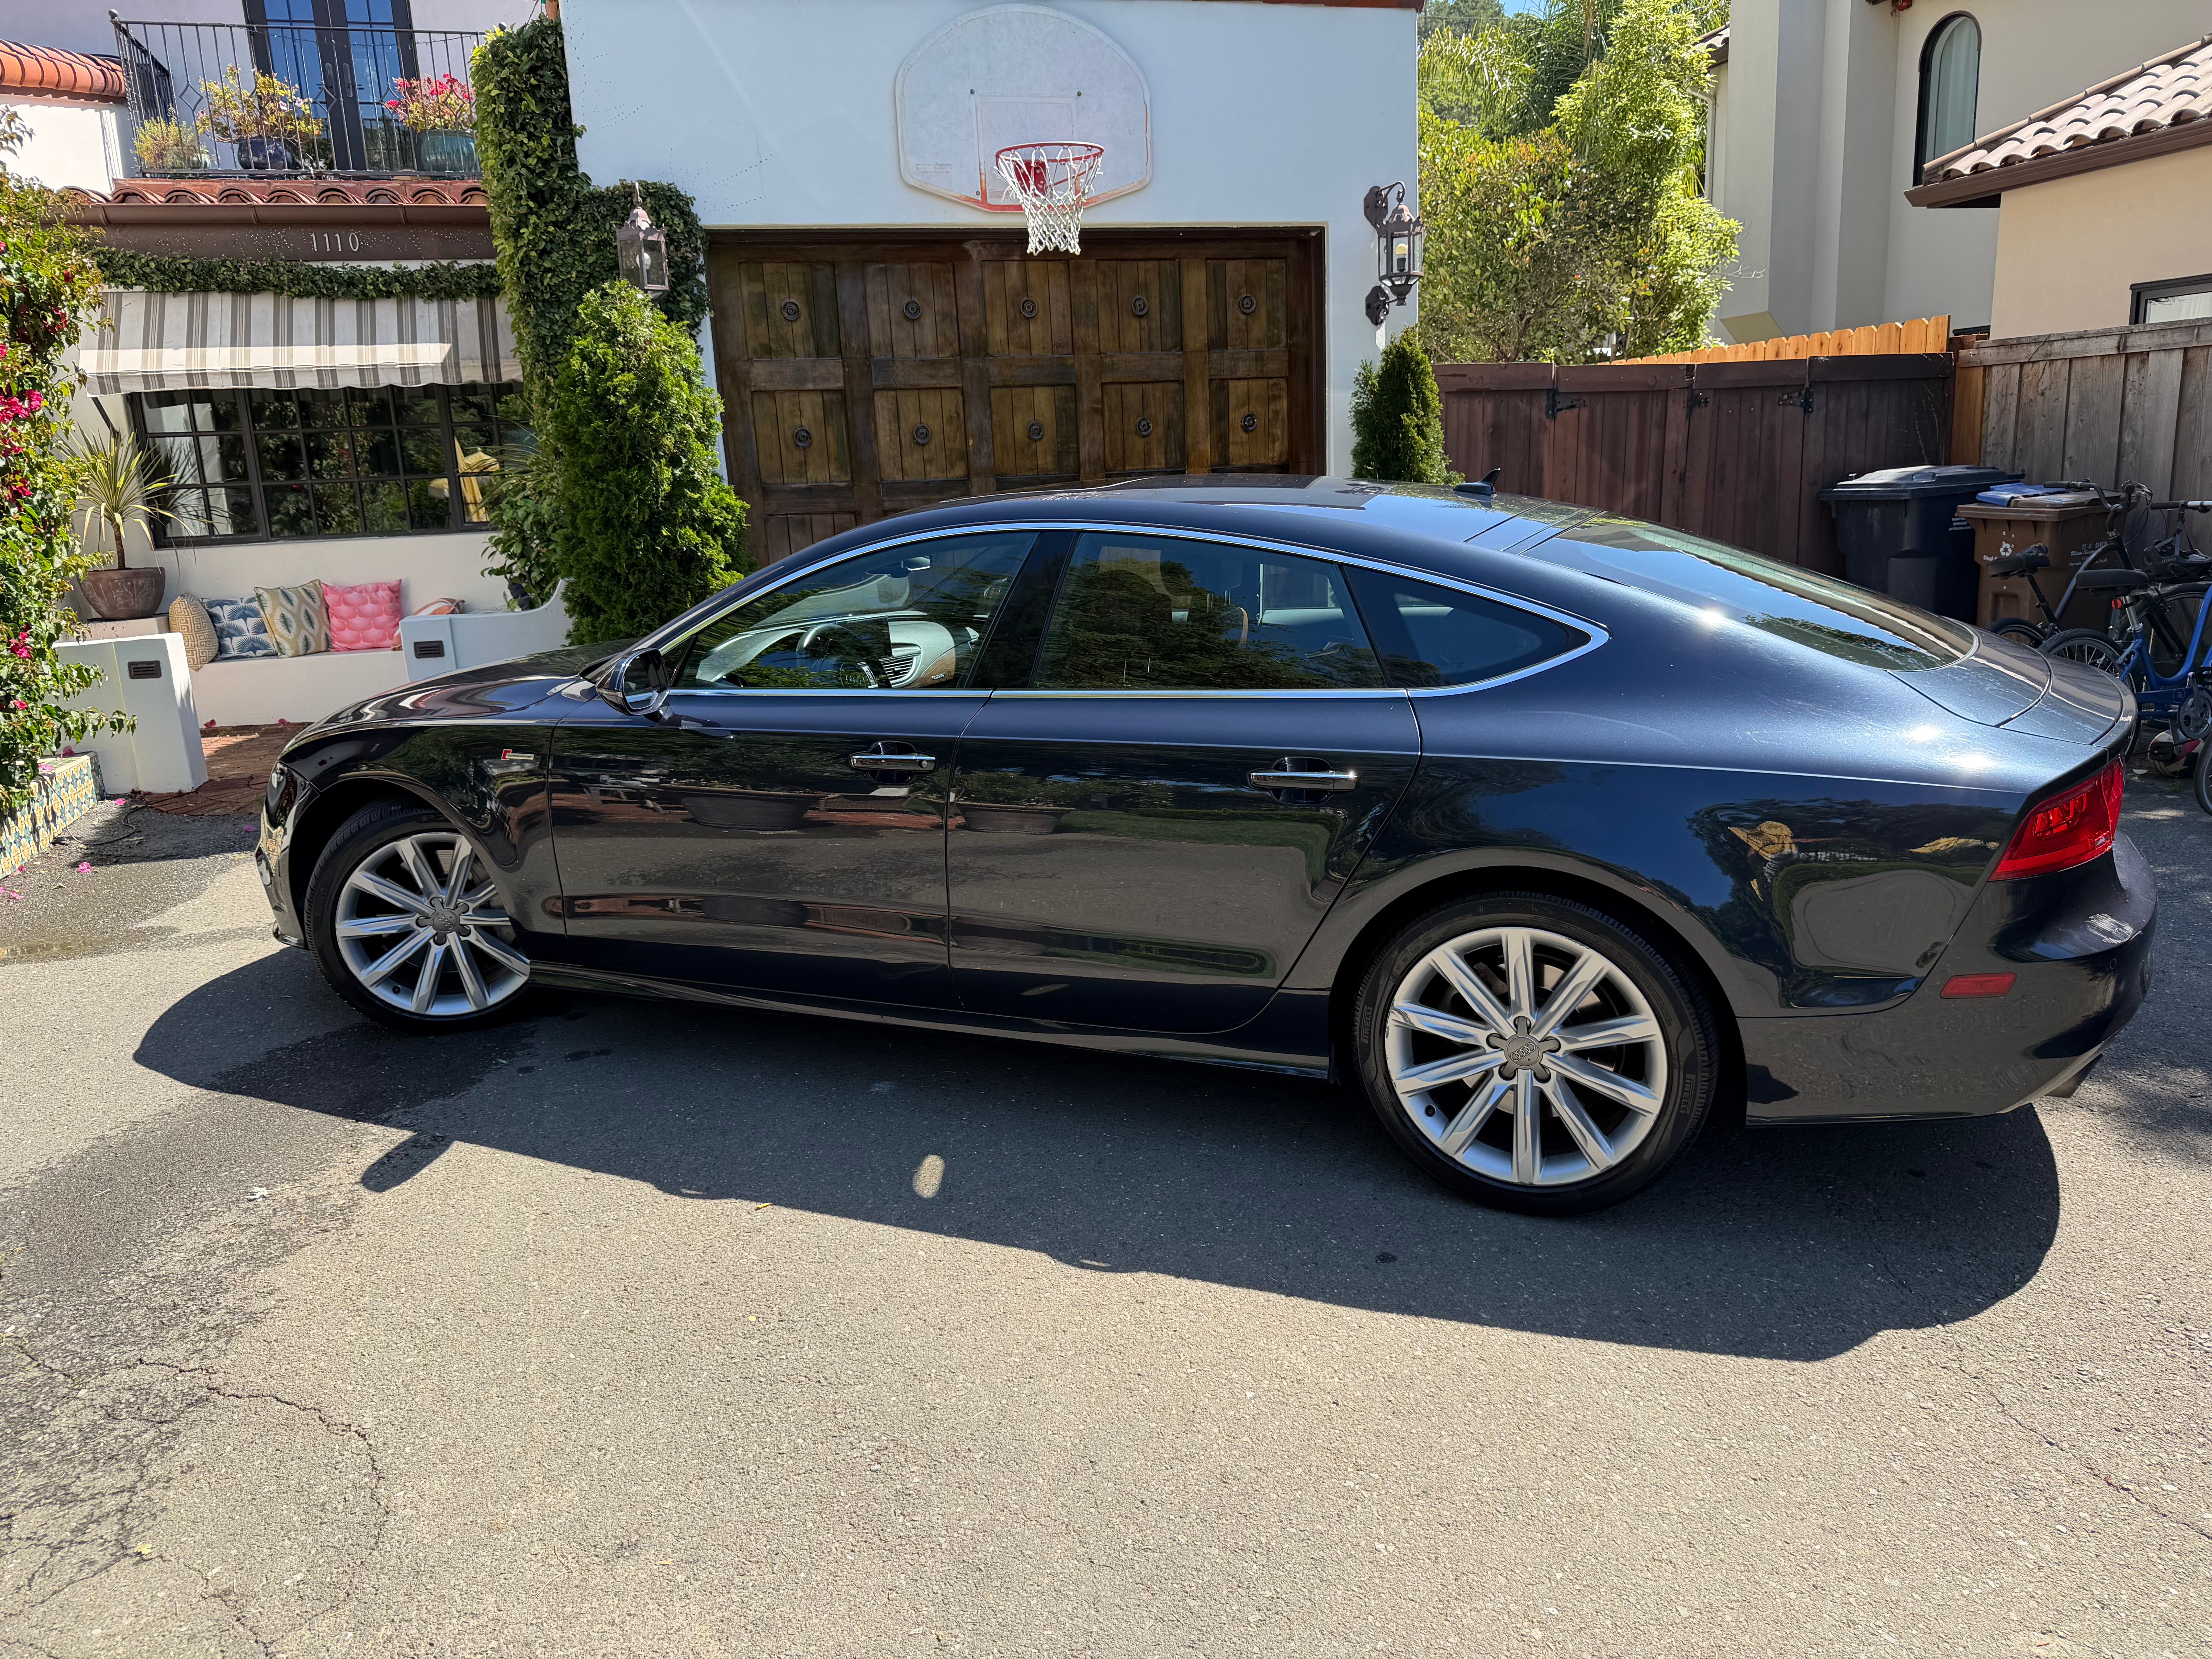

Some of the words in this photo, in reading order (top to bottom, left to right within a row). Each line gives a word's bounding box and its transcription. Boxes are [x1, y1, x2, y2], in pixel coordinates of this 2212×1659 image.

[311, 232, 359, 252] 1110
[1360, 1005, 1372, 1044] PIRELLI
[1680, 1073, 1696, 1115] PIRELLI
